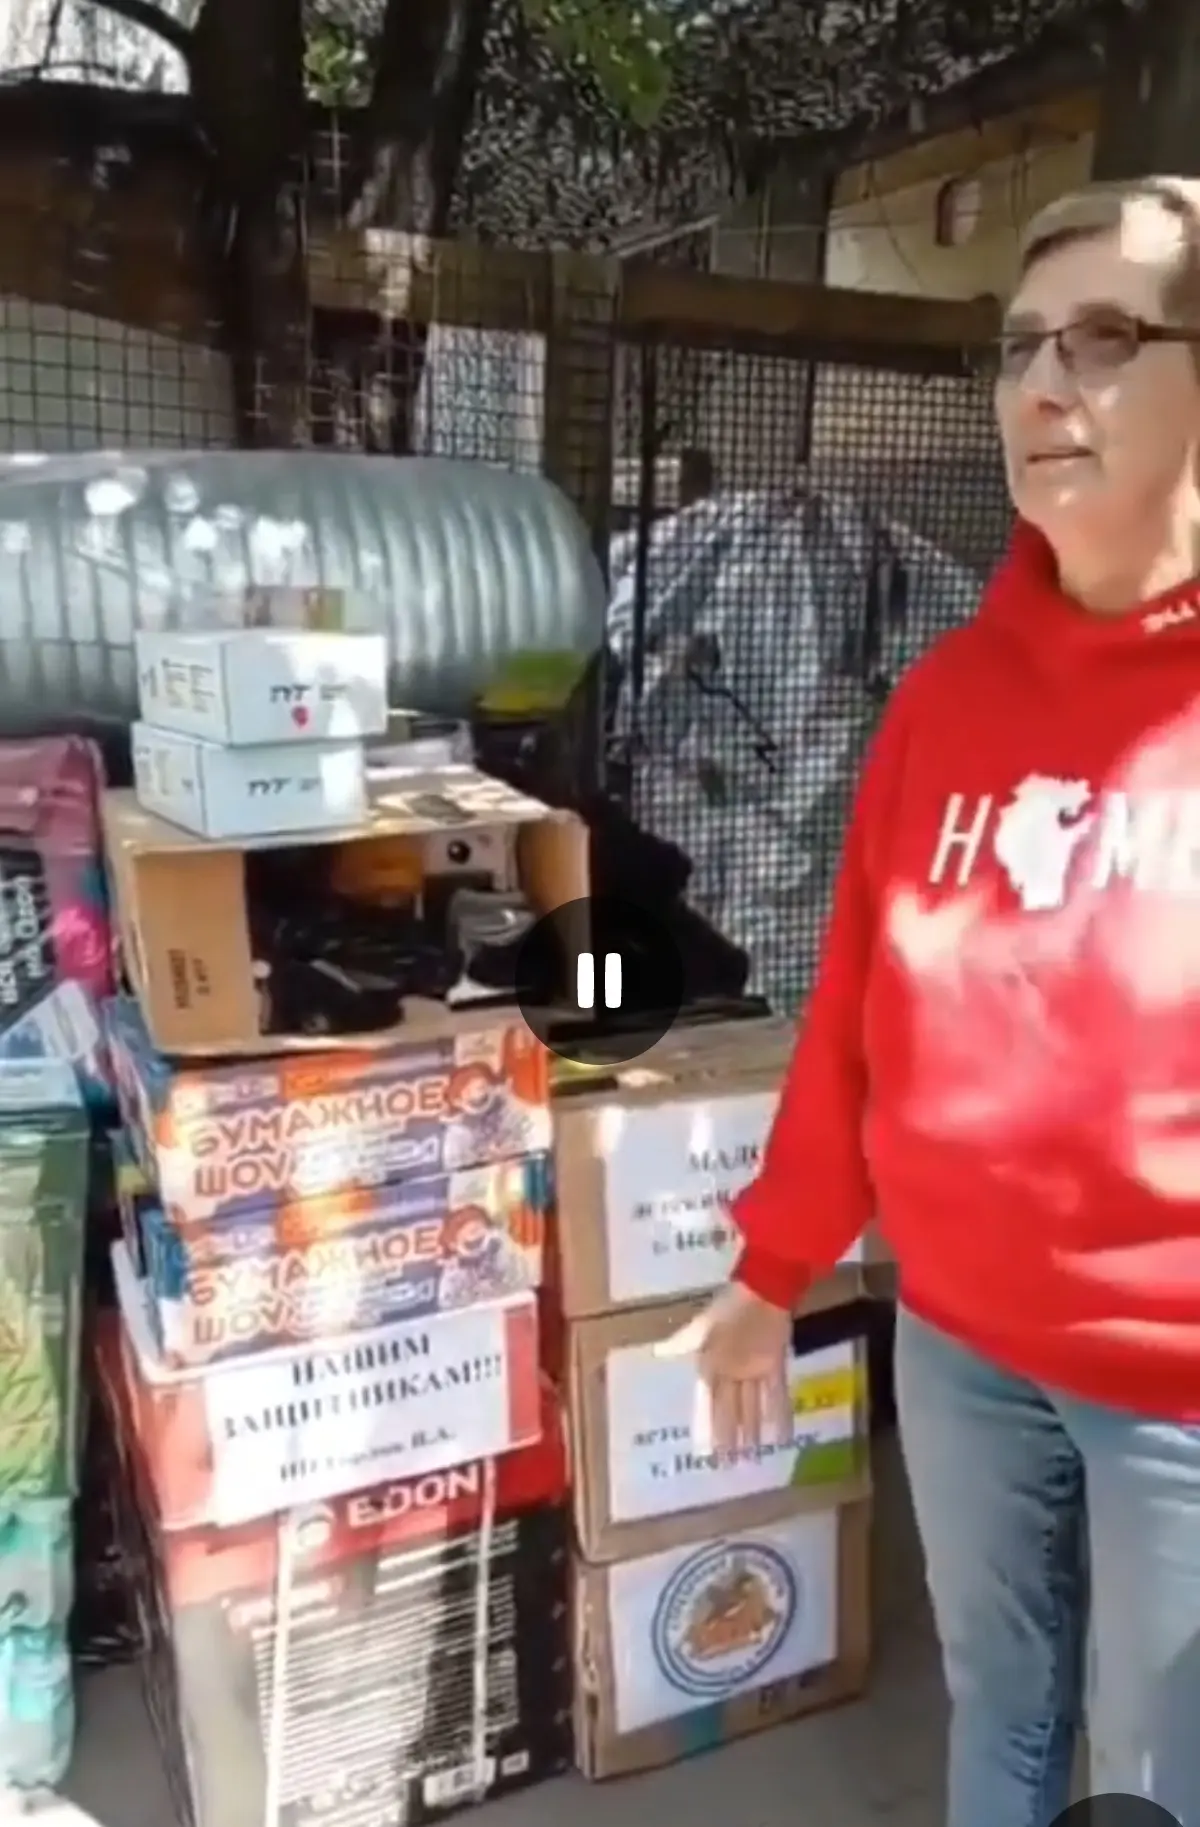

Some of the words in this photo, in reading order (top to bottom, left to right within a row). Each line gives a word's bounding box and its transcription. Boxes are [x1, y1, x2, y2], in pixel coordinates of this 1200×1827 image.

[189, 1078, 444, 1158] БУМАЖНОЕ
[193, 1150, 288, 1197] ШОУ
[291, 1332, 431, 1388] НАШИМ
